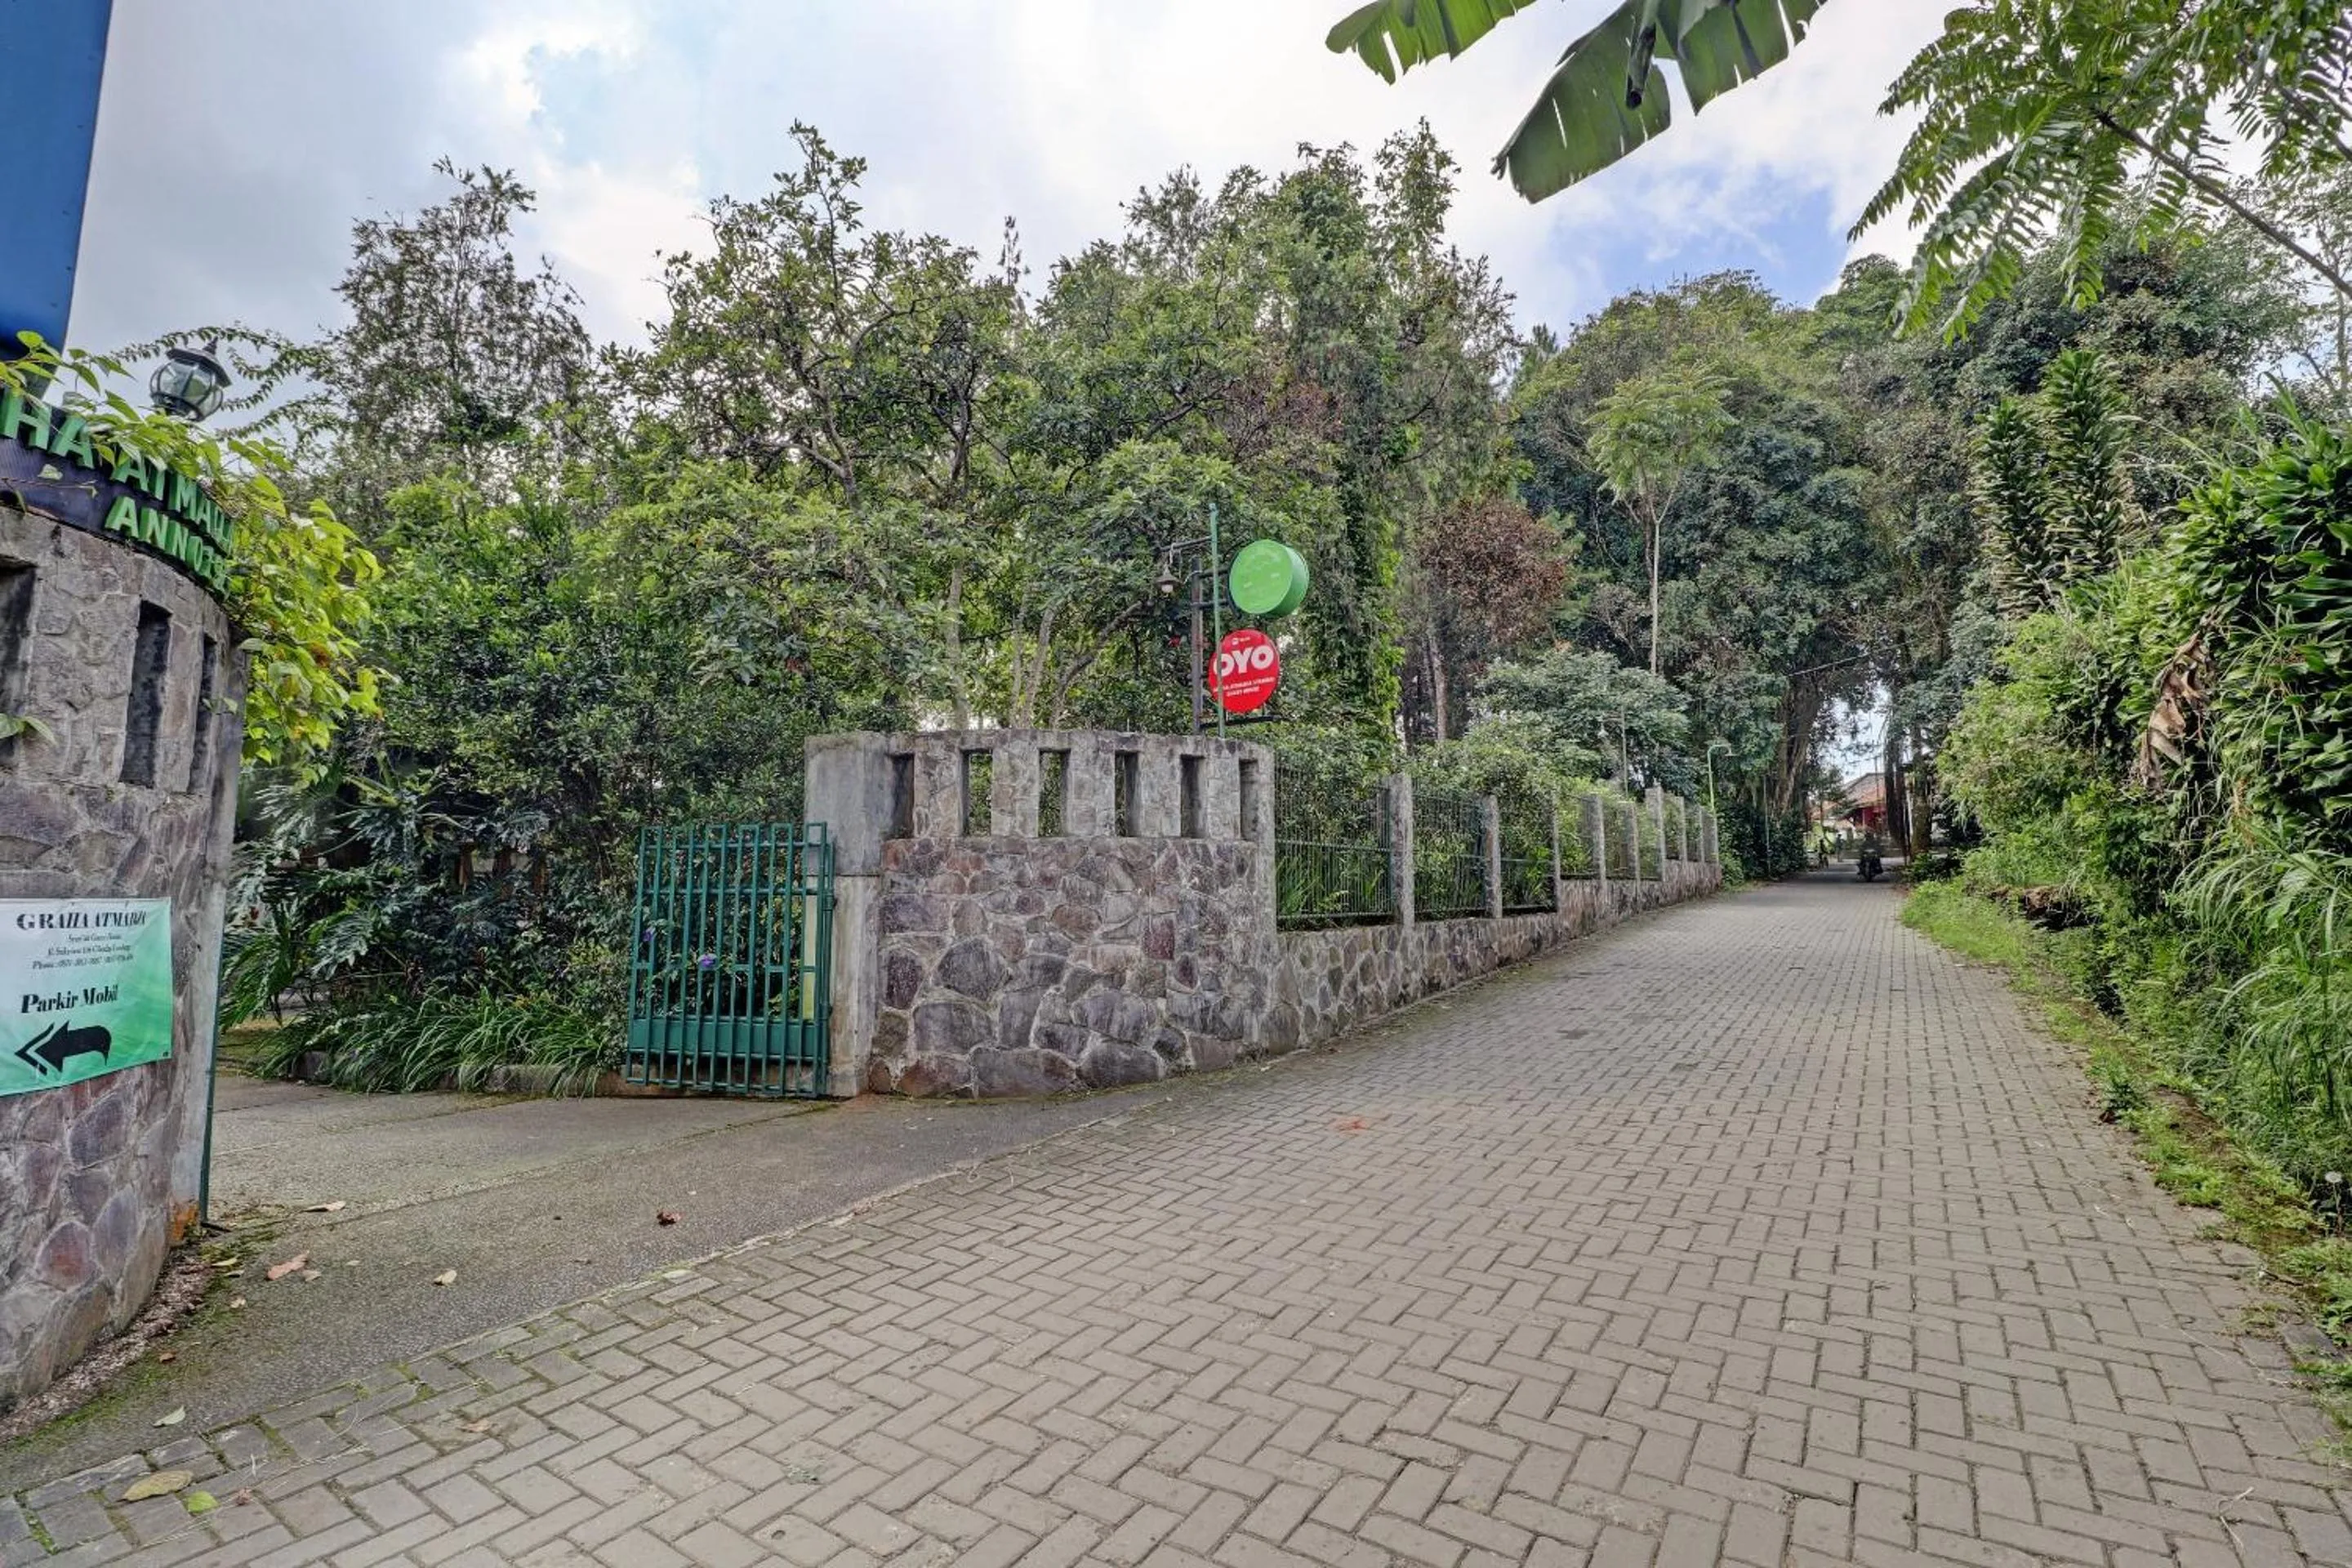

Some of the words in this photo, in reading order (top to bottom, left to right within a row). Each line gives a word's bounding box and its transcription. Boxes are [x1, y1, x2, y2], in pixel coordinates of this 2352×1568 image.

[1213, 645, 1274, 677] OYO
[16, 911, 88, 930] GRAHA
[21, 991, 78, 1013] Parkir
[80, 984, 118, 1007] Mobil
